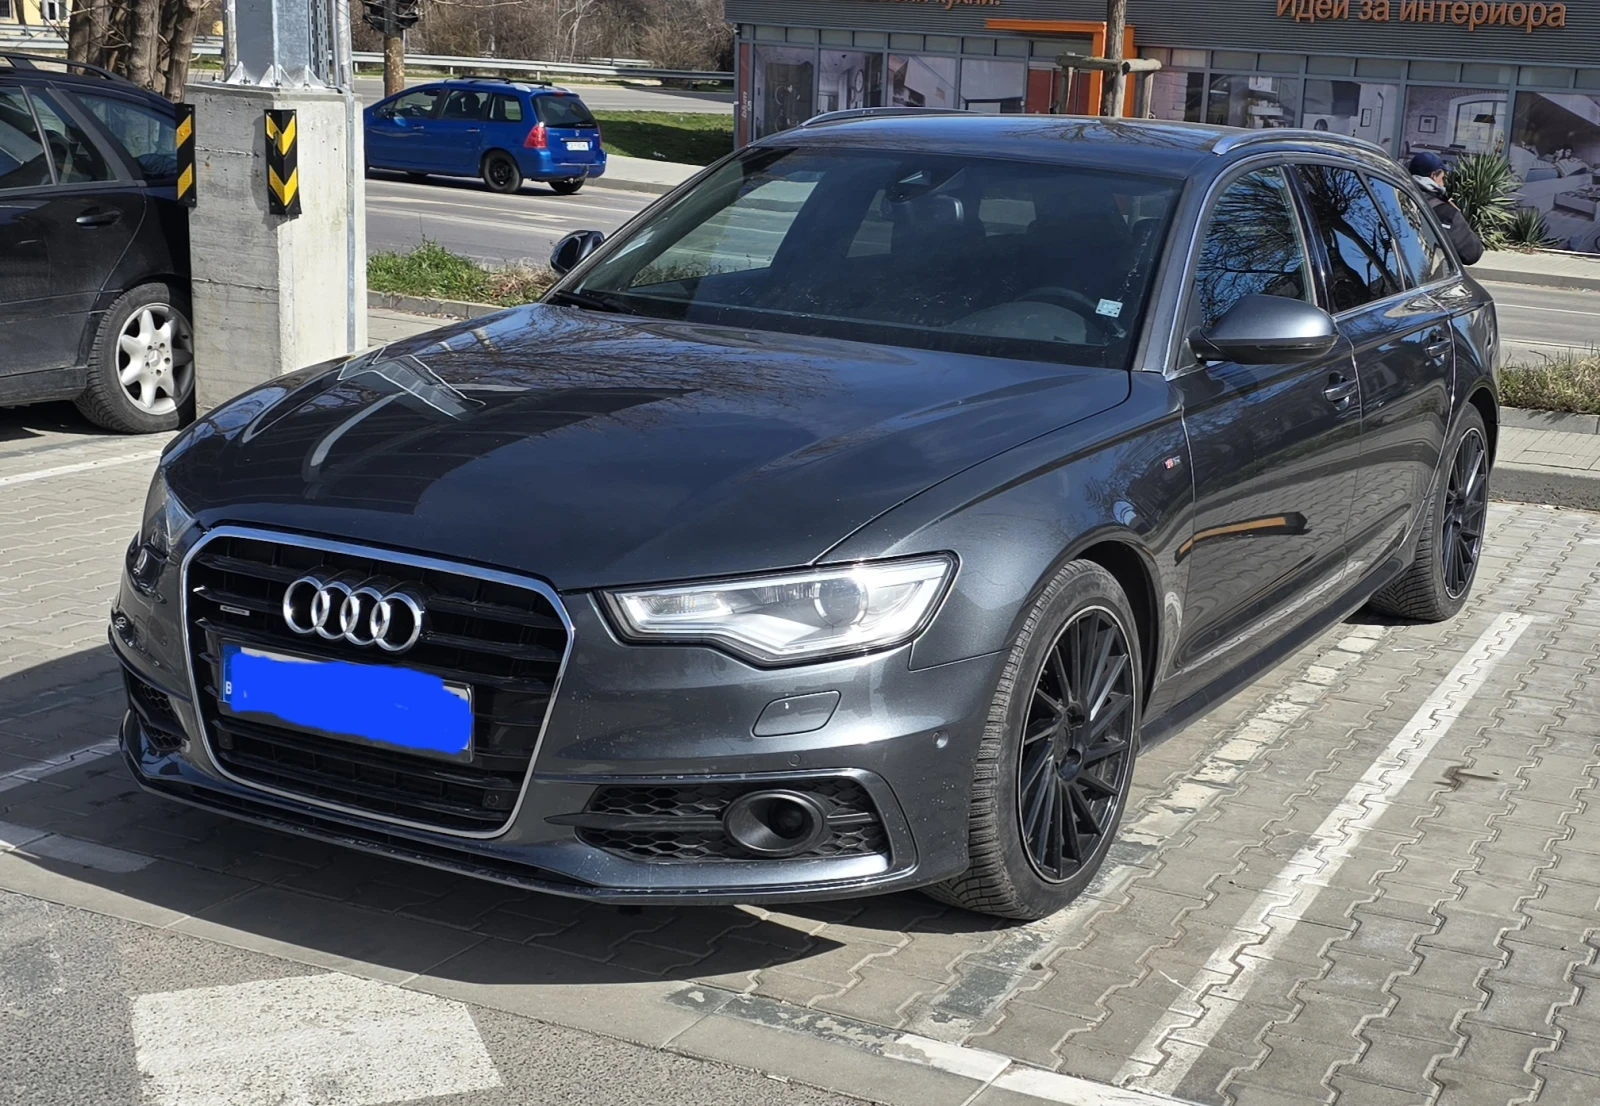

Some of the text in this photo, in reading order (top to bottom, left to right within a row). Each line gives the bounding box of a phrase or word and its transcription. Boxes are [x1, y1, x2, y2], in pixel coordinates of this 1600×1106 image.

[1276, 0, 1567, 33] Идеи за интериора
